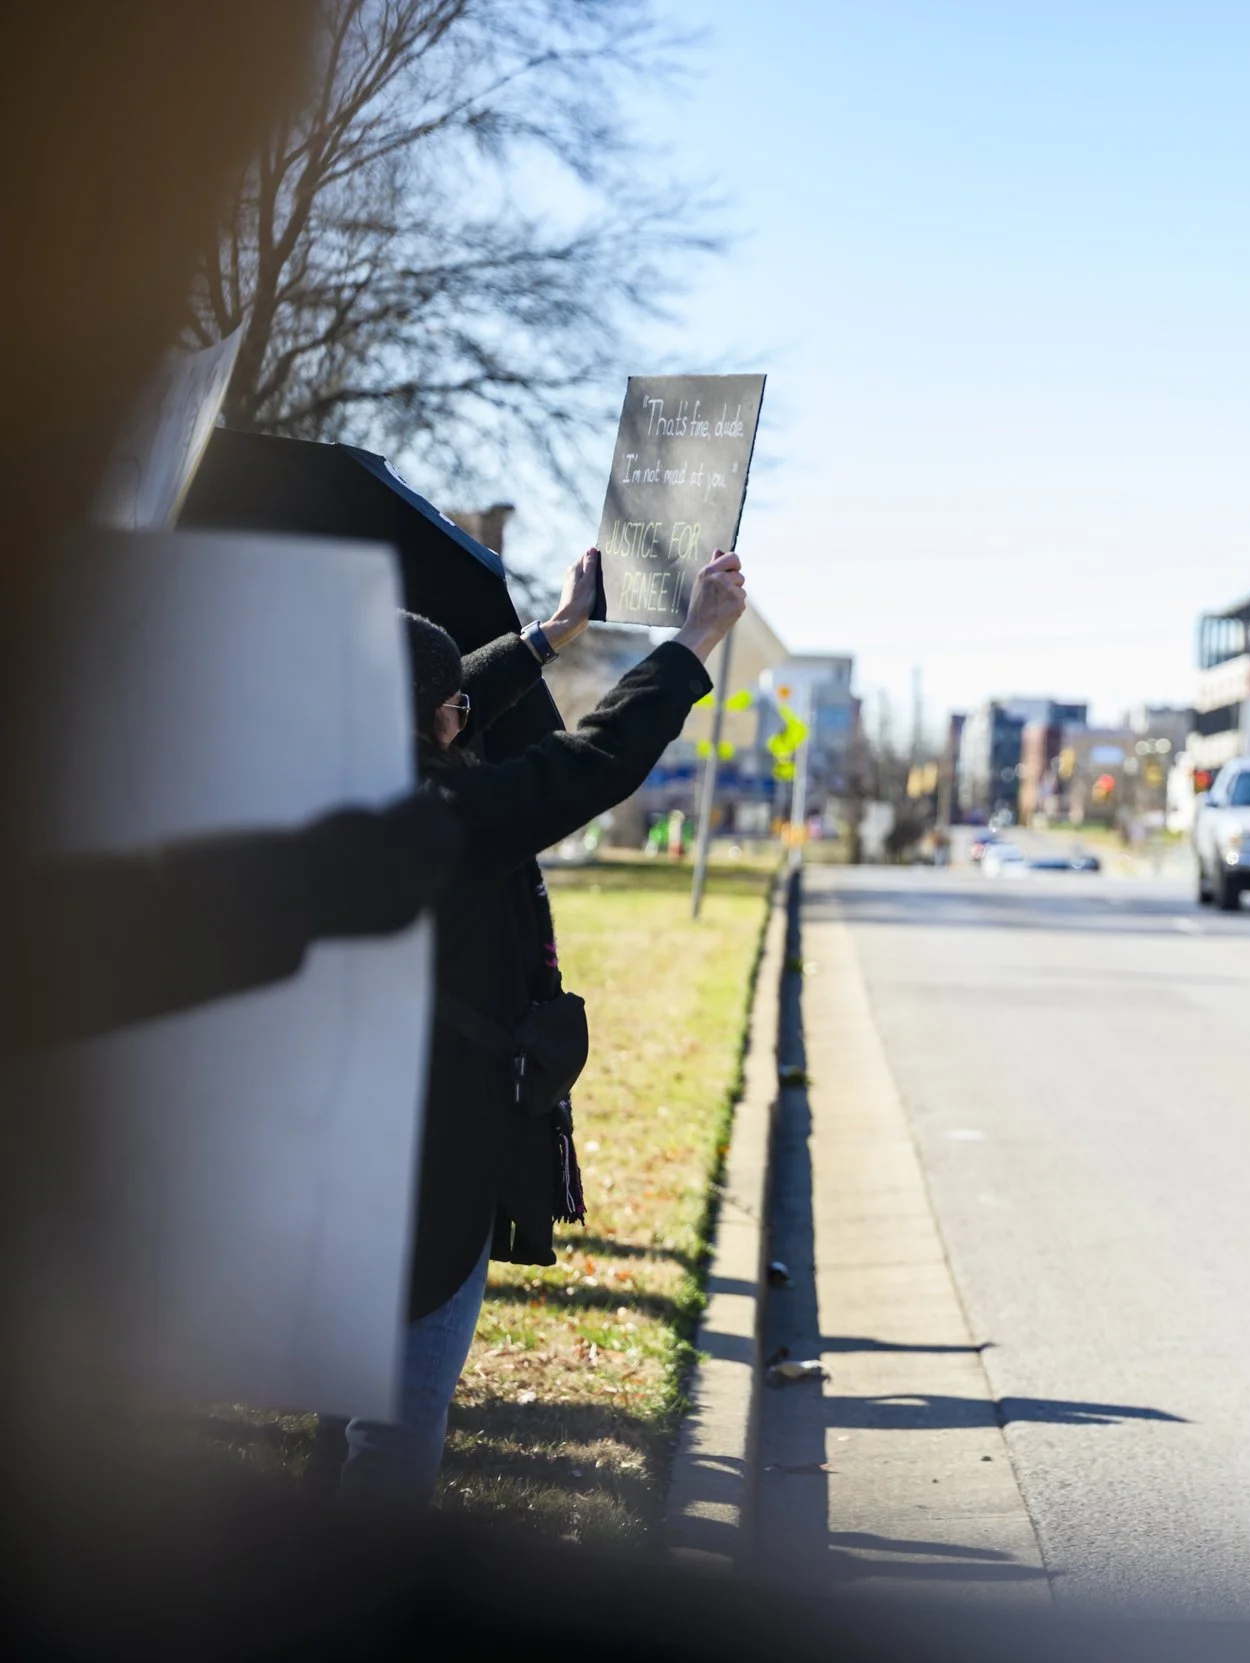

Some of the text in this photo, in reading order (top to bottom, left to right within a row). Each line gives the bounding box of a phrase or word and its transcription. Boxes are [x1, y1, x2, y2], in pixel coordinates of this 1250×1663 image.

[643, 459, 660, 482] not
[663, 461, 687, 485] mad
[689, 462, 704, 487] at
[605, 520, 701, 560] JUSTICE FOR
